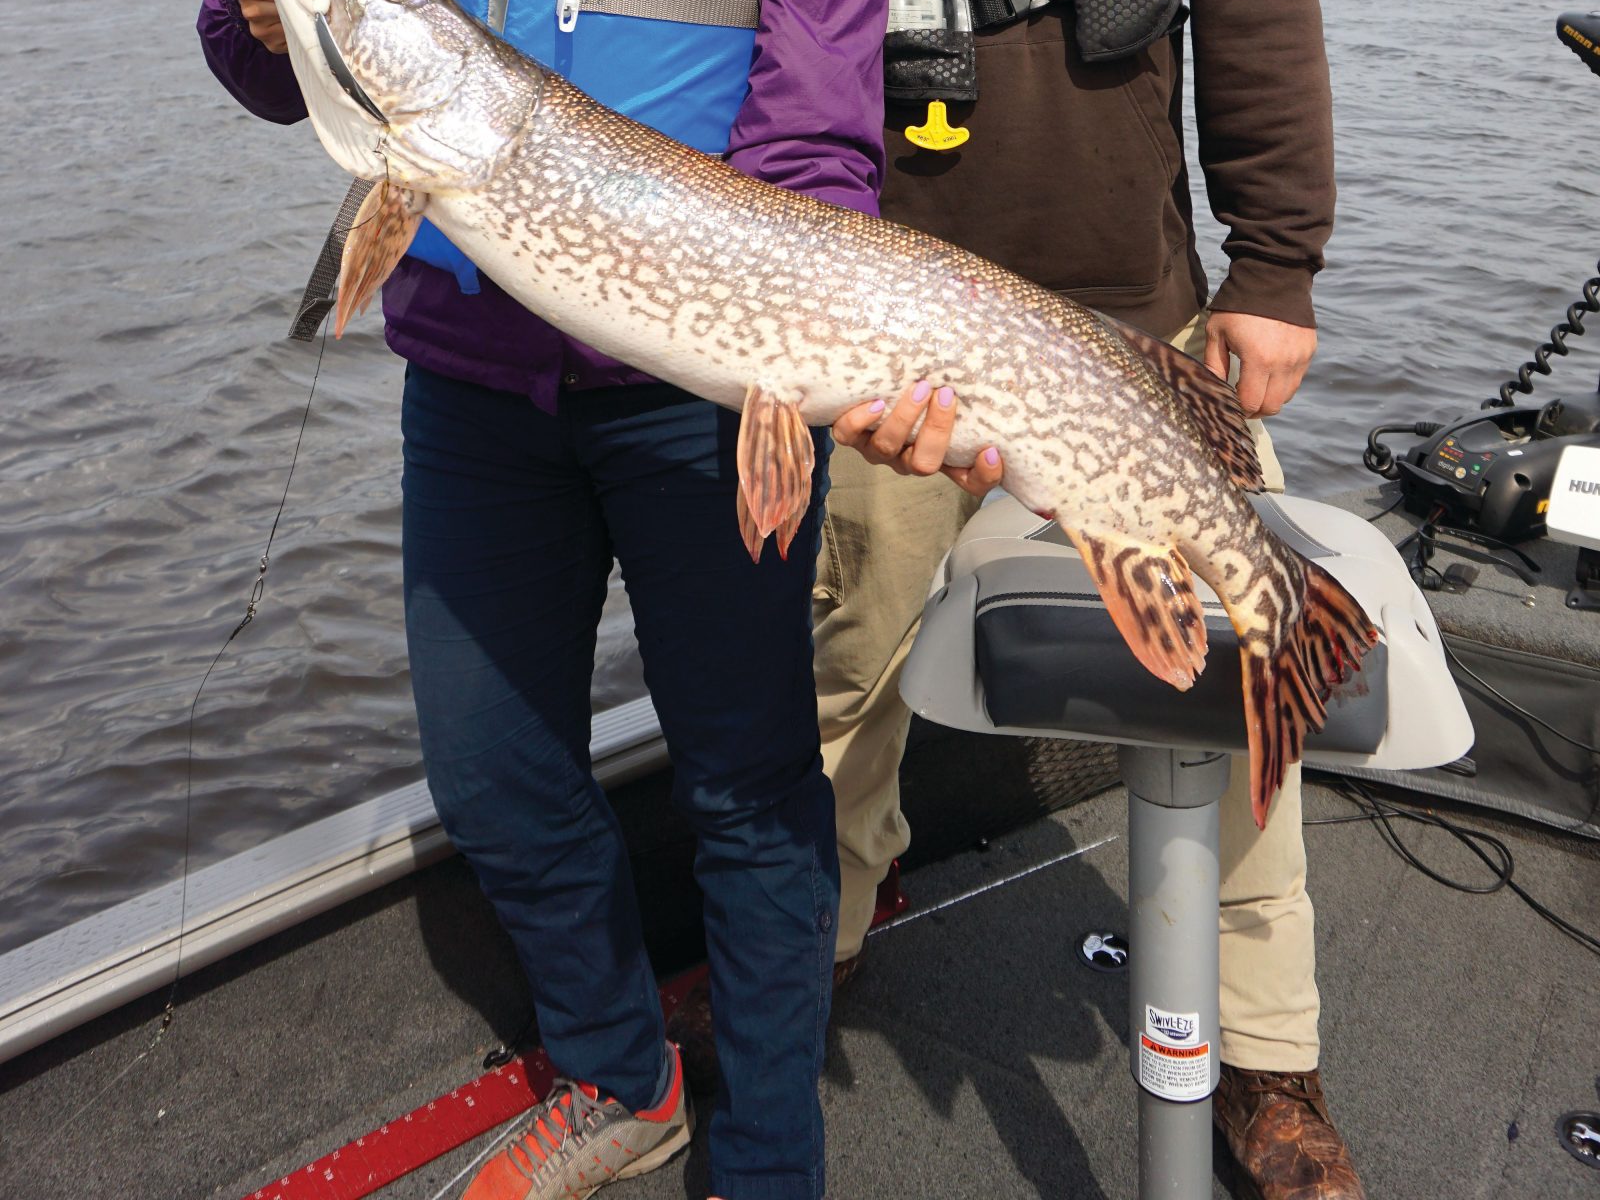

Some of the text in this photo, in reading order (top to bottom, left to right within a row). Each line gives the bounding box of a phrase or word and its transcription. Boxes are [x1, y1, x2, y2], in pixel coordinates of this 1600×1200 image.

[1149, 1008, 1193, 1030] SWIVL-EZE
[1158, 1047, 1200, 1057] WARNING
[405, 1114, 413, 1123] 24
[381, 1126, 389, 1136] 25
[356, 1138, 364, 1147] 26
[333, 1150, 340, 1160] 27
